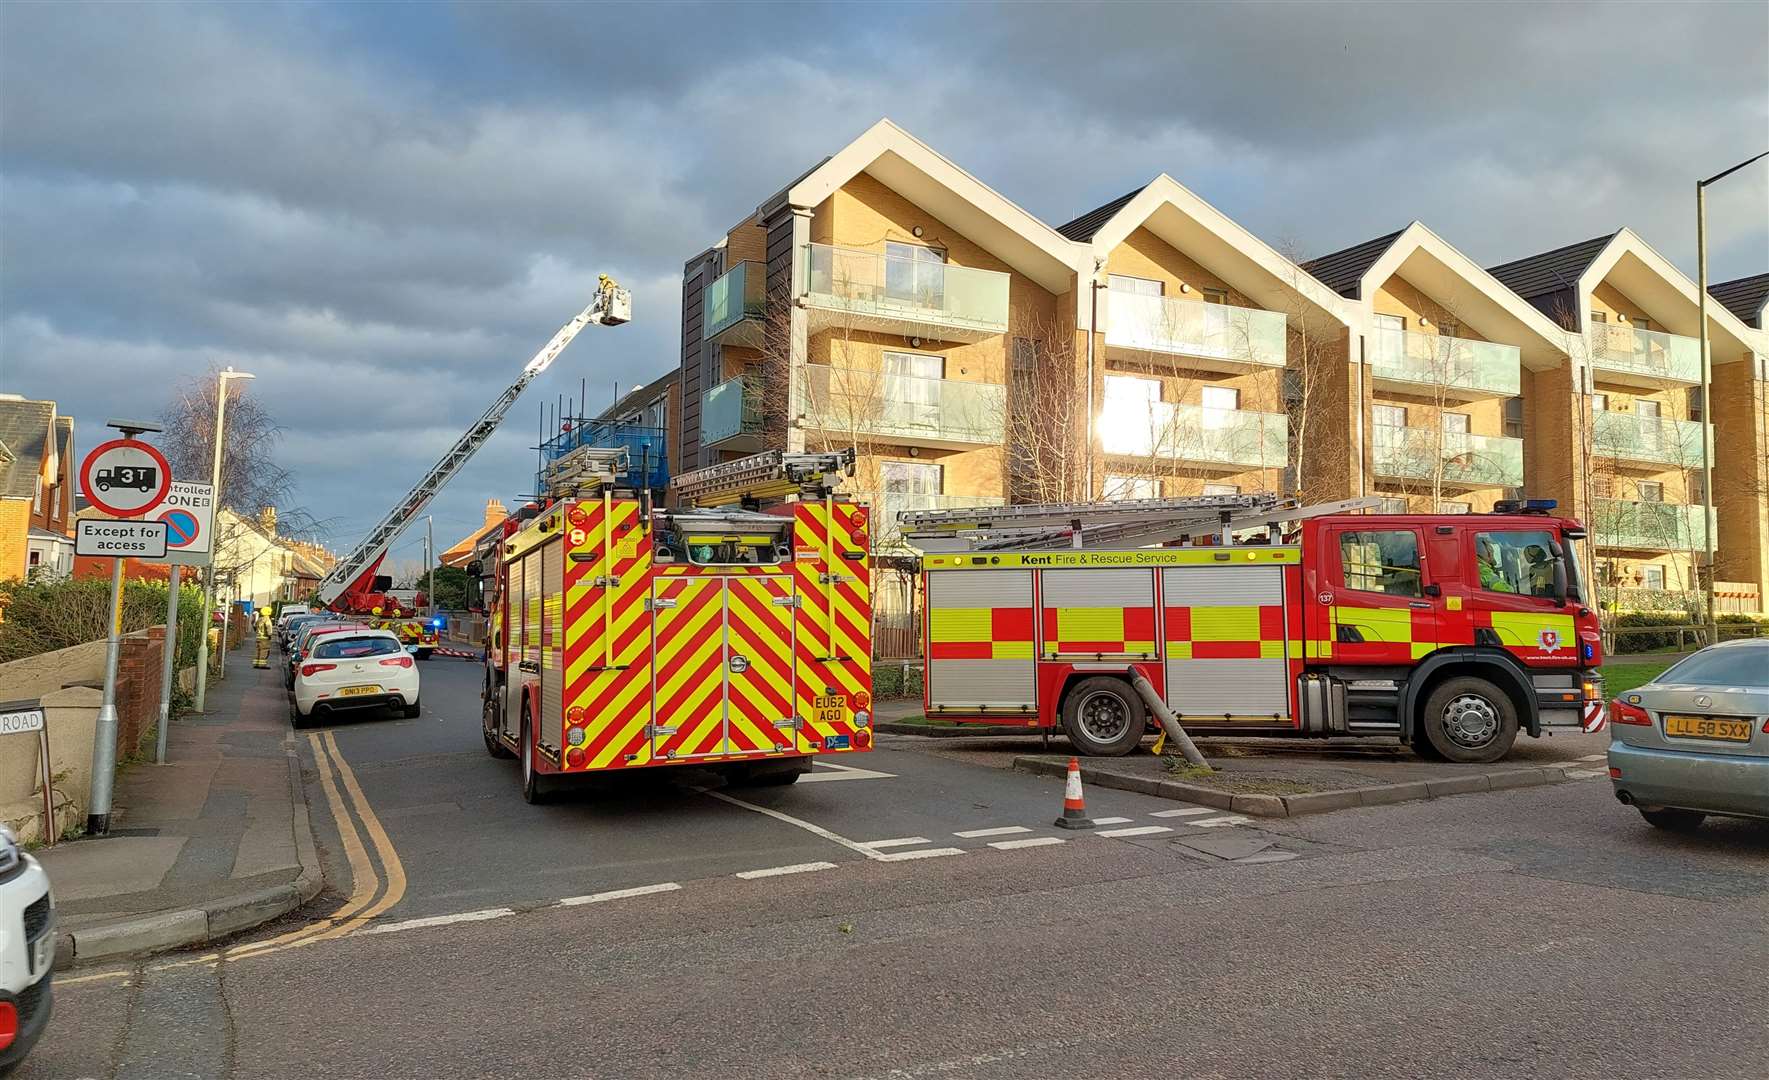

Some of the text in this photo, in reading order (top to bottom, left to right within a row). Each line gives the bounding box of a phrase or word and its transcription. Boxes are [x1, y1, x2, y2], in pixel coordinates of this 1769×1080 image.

[160, 495, 200, 507] ONE
[84, 525, 160, 538] Except for
[97, 540, 146, 551] access
[1021, 553, 1177, 565] Kent Fire & Rescue Service
[1320, 594, 1332, 602] 137
[815, 696, 845, 708] EU62
[820, 709, 841, 721] AGO
[3, 713, 39, 731] ROAD
[1676, 722, 1748, 737] LL 58 SXX
